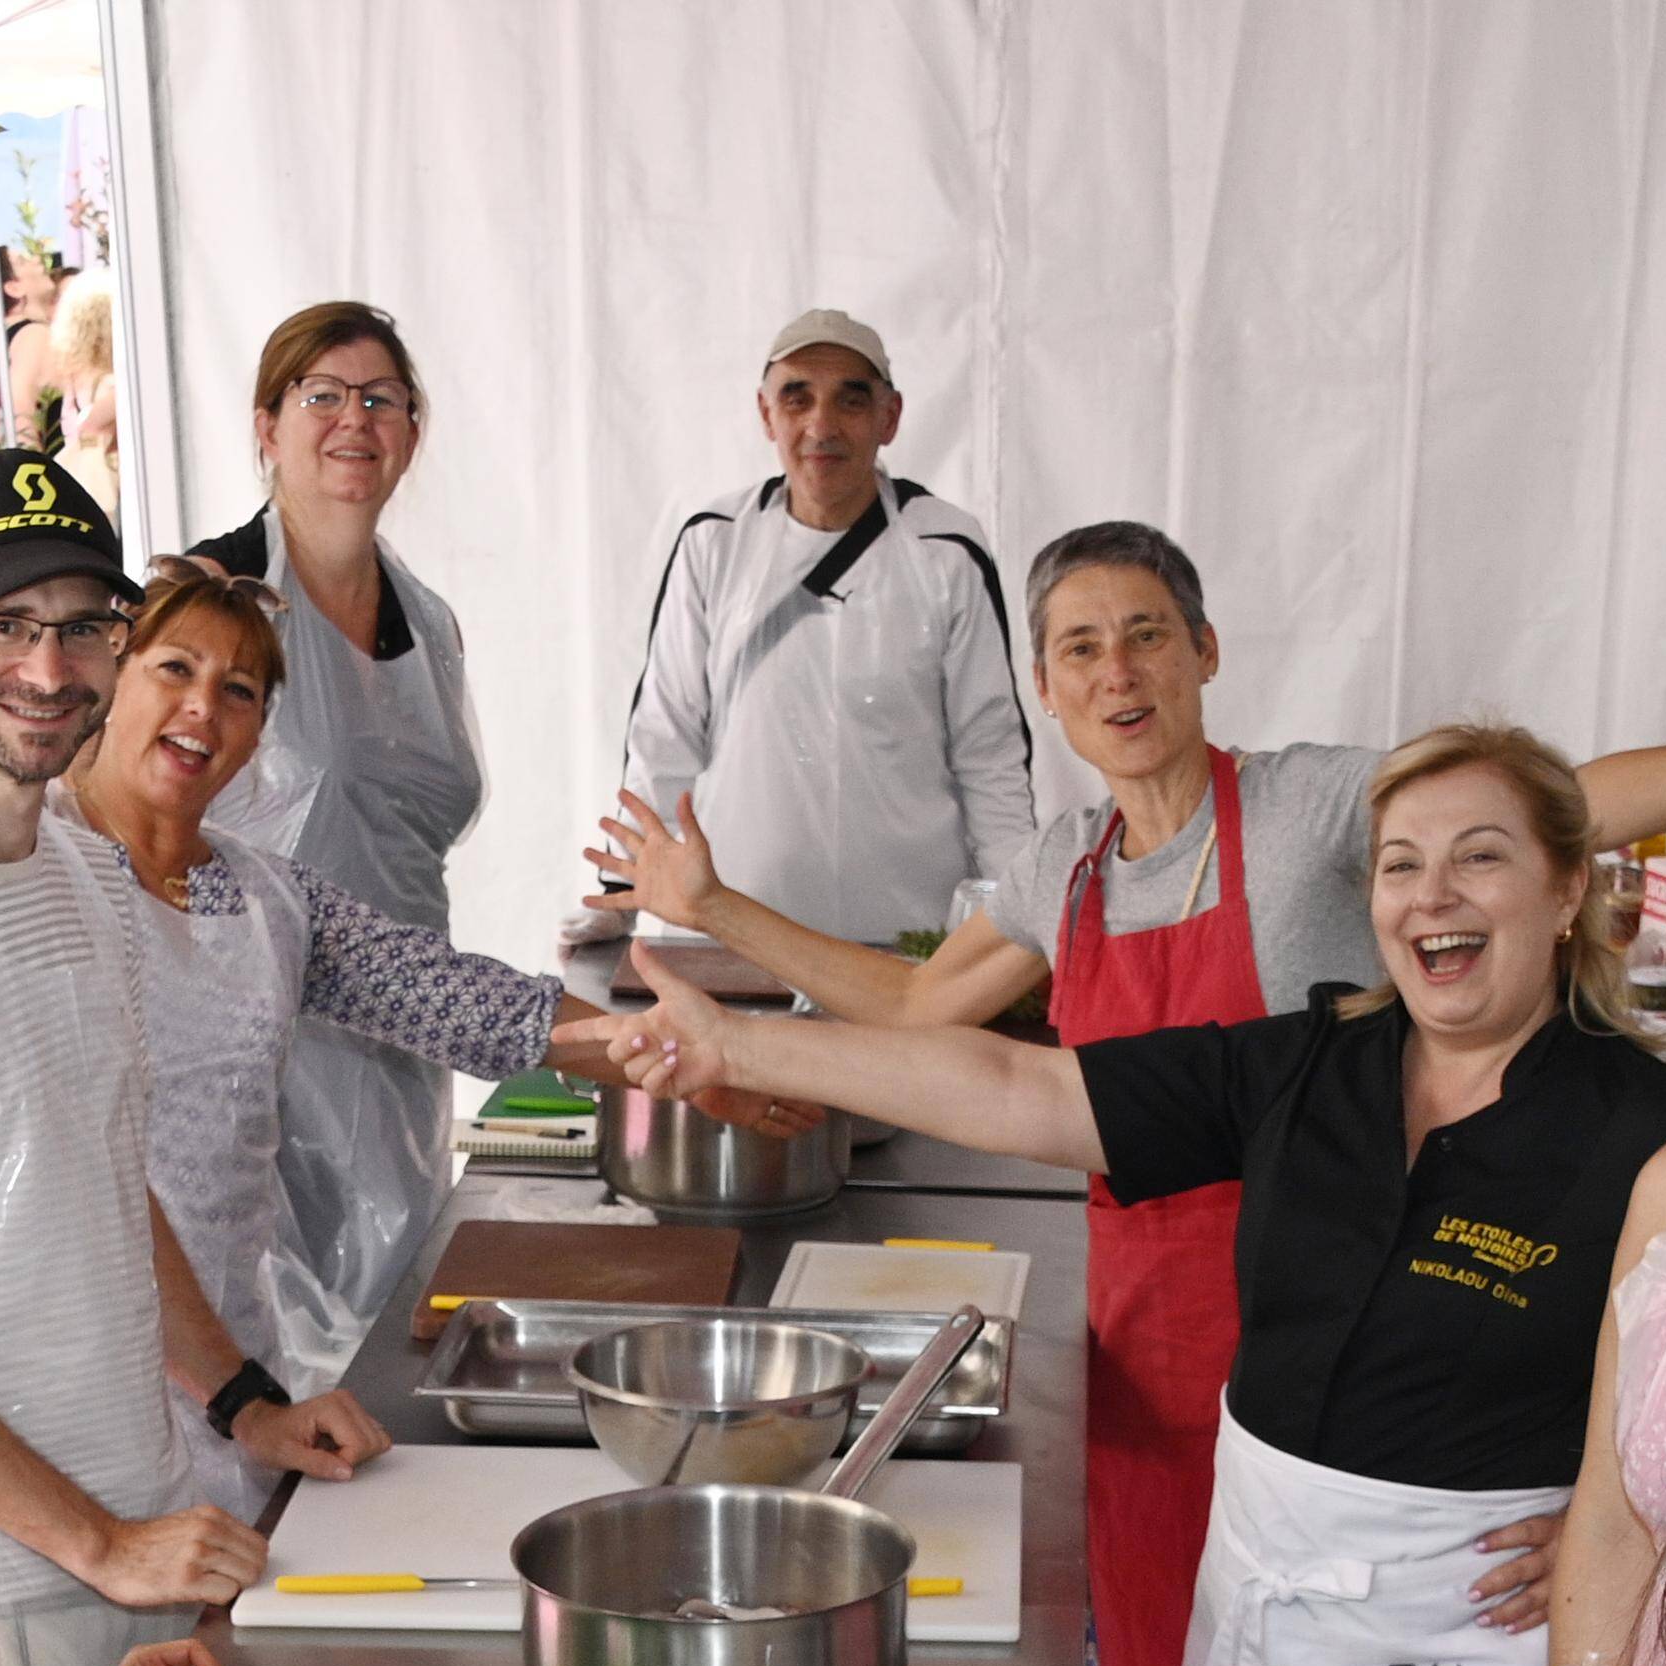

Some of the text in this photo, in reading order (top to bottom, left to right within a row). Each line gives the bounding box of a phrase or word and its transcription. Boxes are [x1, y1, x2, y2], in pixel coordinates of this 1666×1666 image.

[1433, 1229, 1455, 1243] DE
[1455, 1232, 1528, 1265] MOUGINS
[1440, 1215, 1534, 1254] LES ETOILES
[1408, 1259, 1489, 1290] NIKOLAOU
